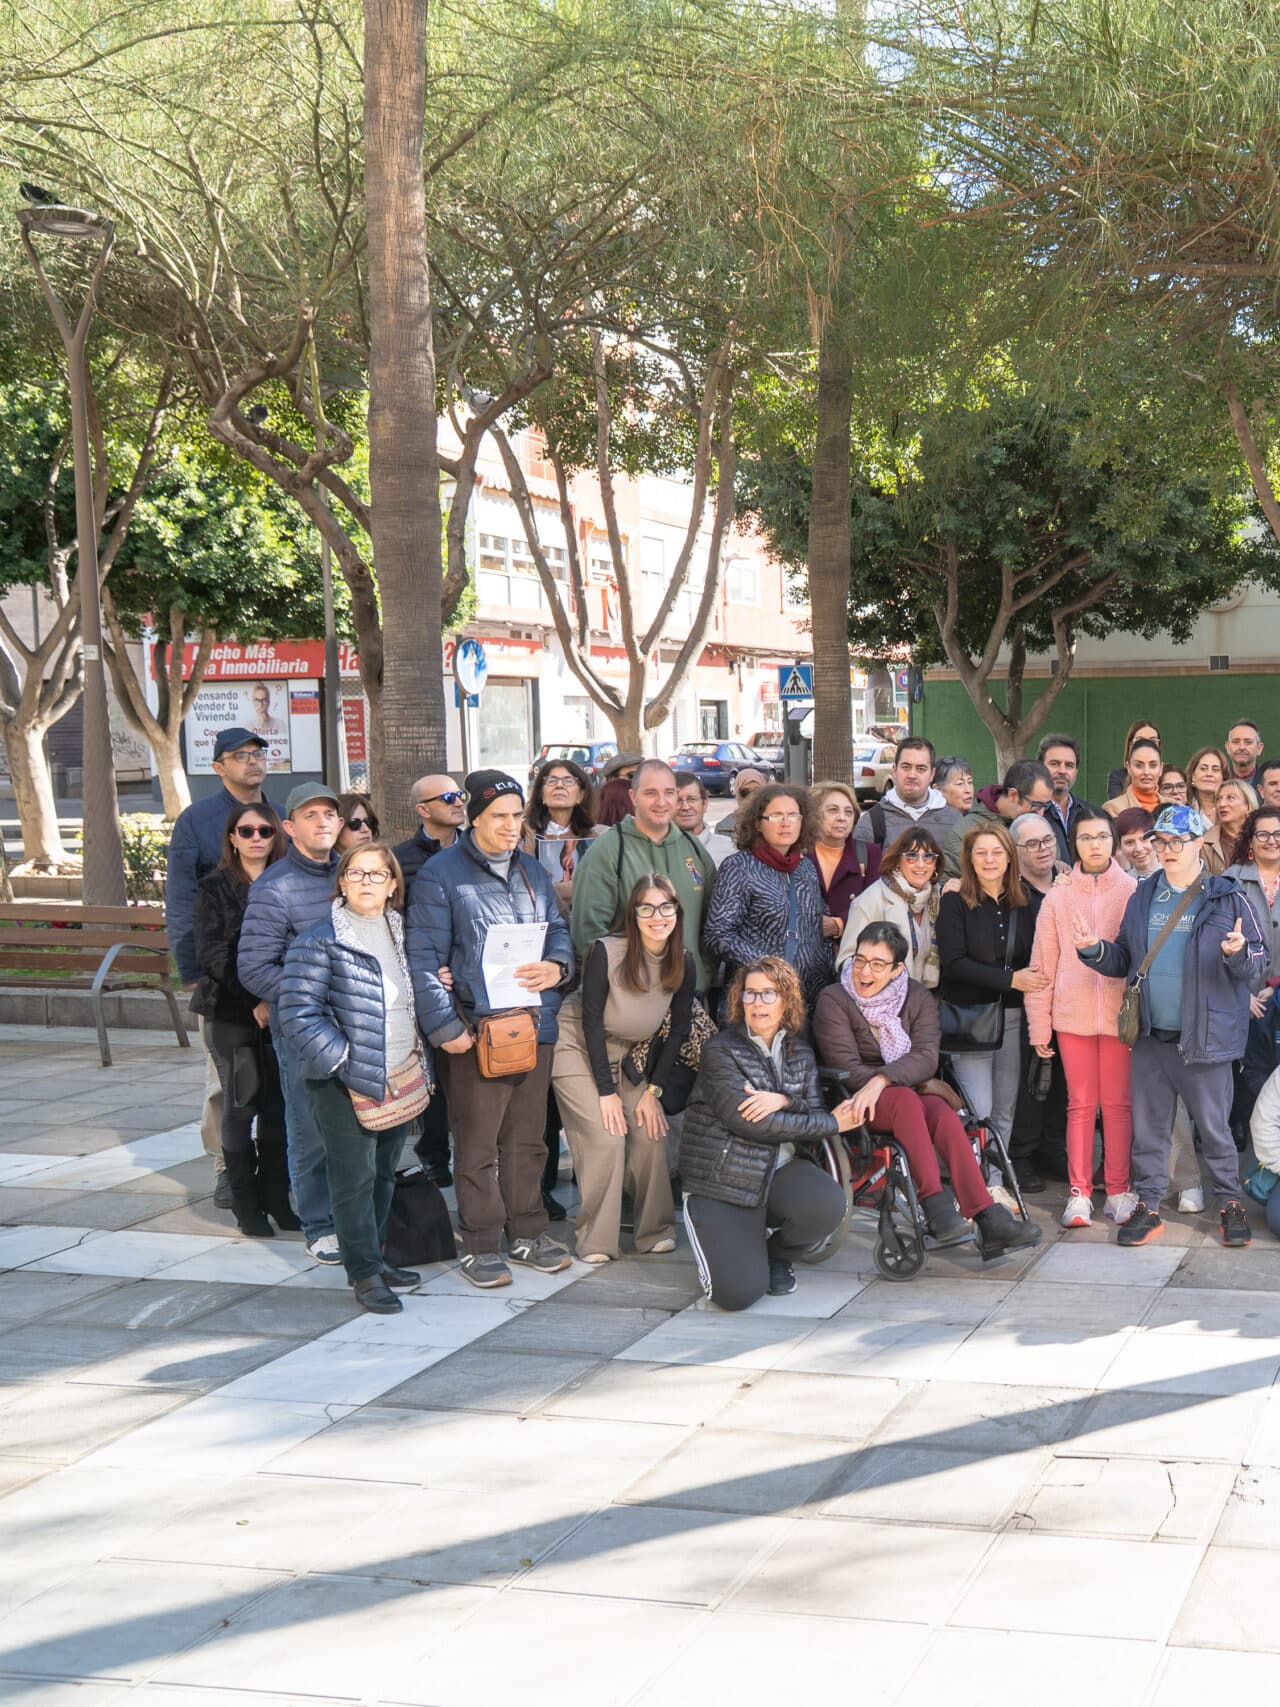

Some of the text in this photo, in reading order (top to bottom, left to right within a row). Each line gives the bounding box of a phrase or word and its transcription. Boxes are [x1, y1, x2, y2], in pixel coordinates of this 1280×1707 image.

[244, 643, 276, 660] Más
[220, 657, 309, 675] Inmobiliaria
[197, 690, 239, 700] ensando
[192, 701, 239, 711] Vender tu
[195, 711, 236, 721] Vivienda
